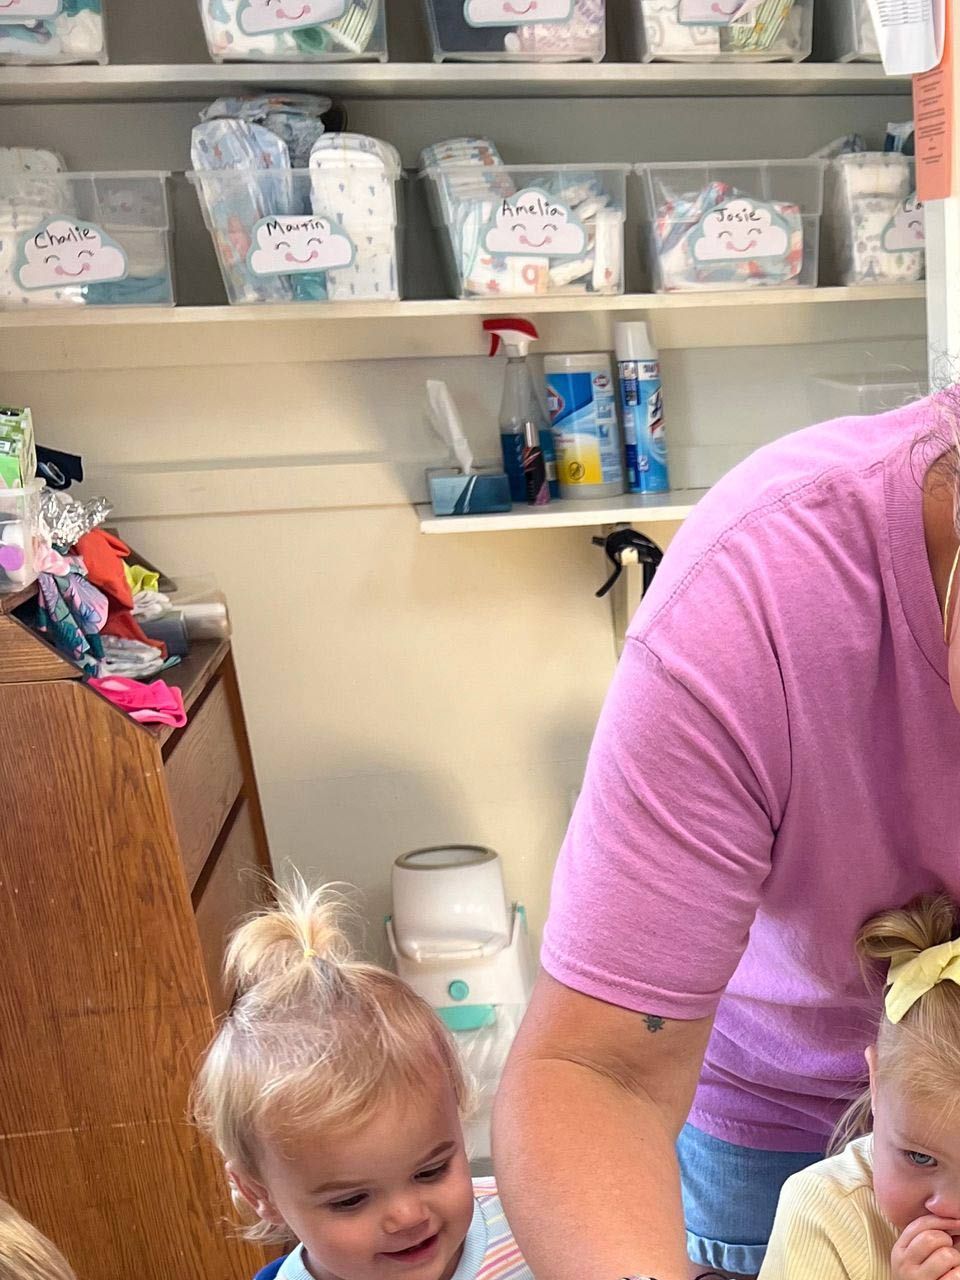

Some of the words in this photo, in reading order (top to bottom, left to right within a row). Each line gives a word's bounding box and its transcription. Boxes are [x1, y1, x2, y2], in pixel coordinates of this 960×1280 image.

[501, 197, 565, 217] Amelia
[713, 207, 762, 224] Josie
[33, 226, 97, 249] Charlie
